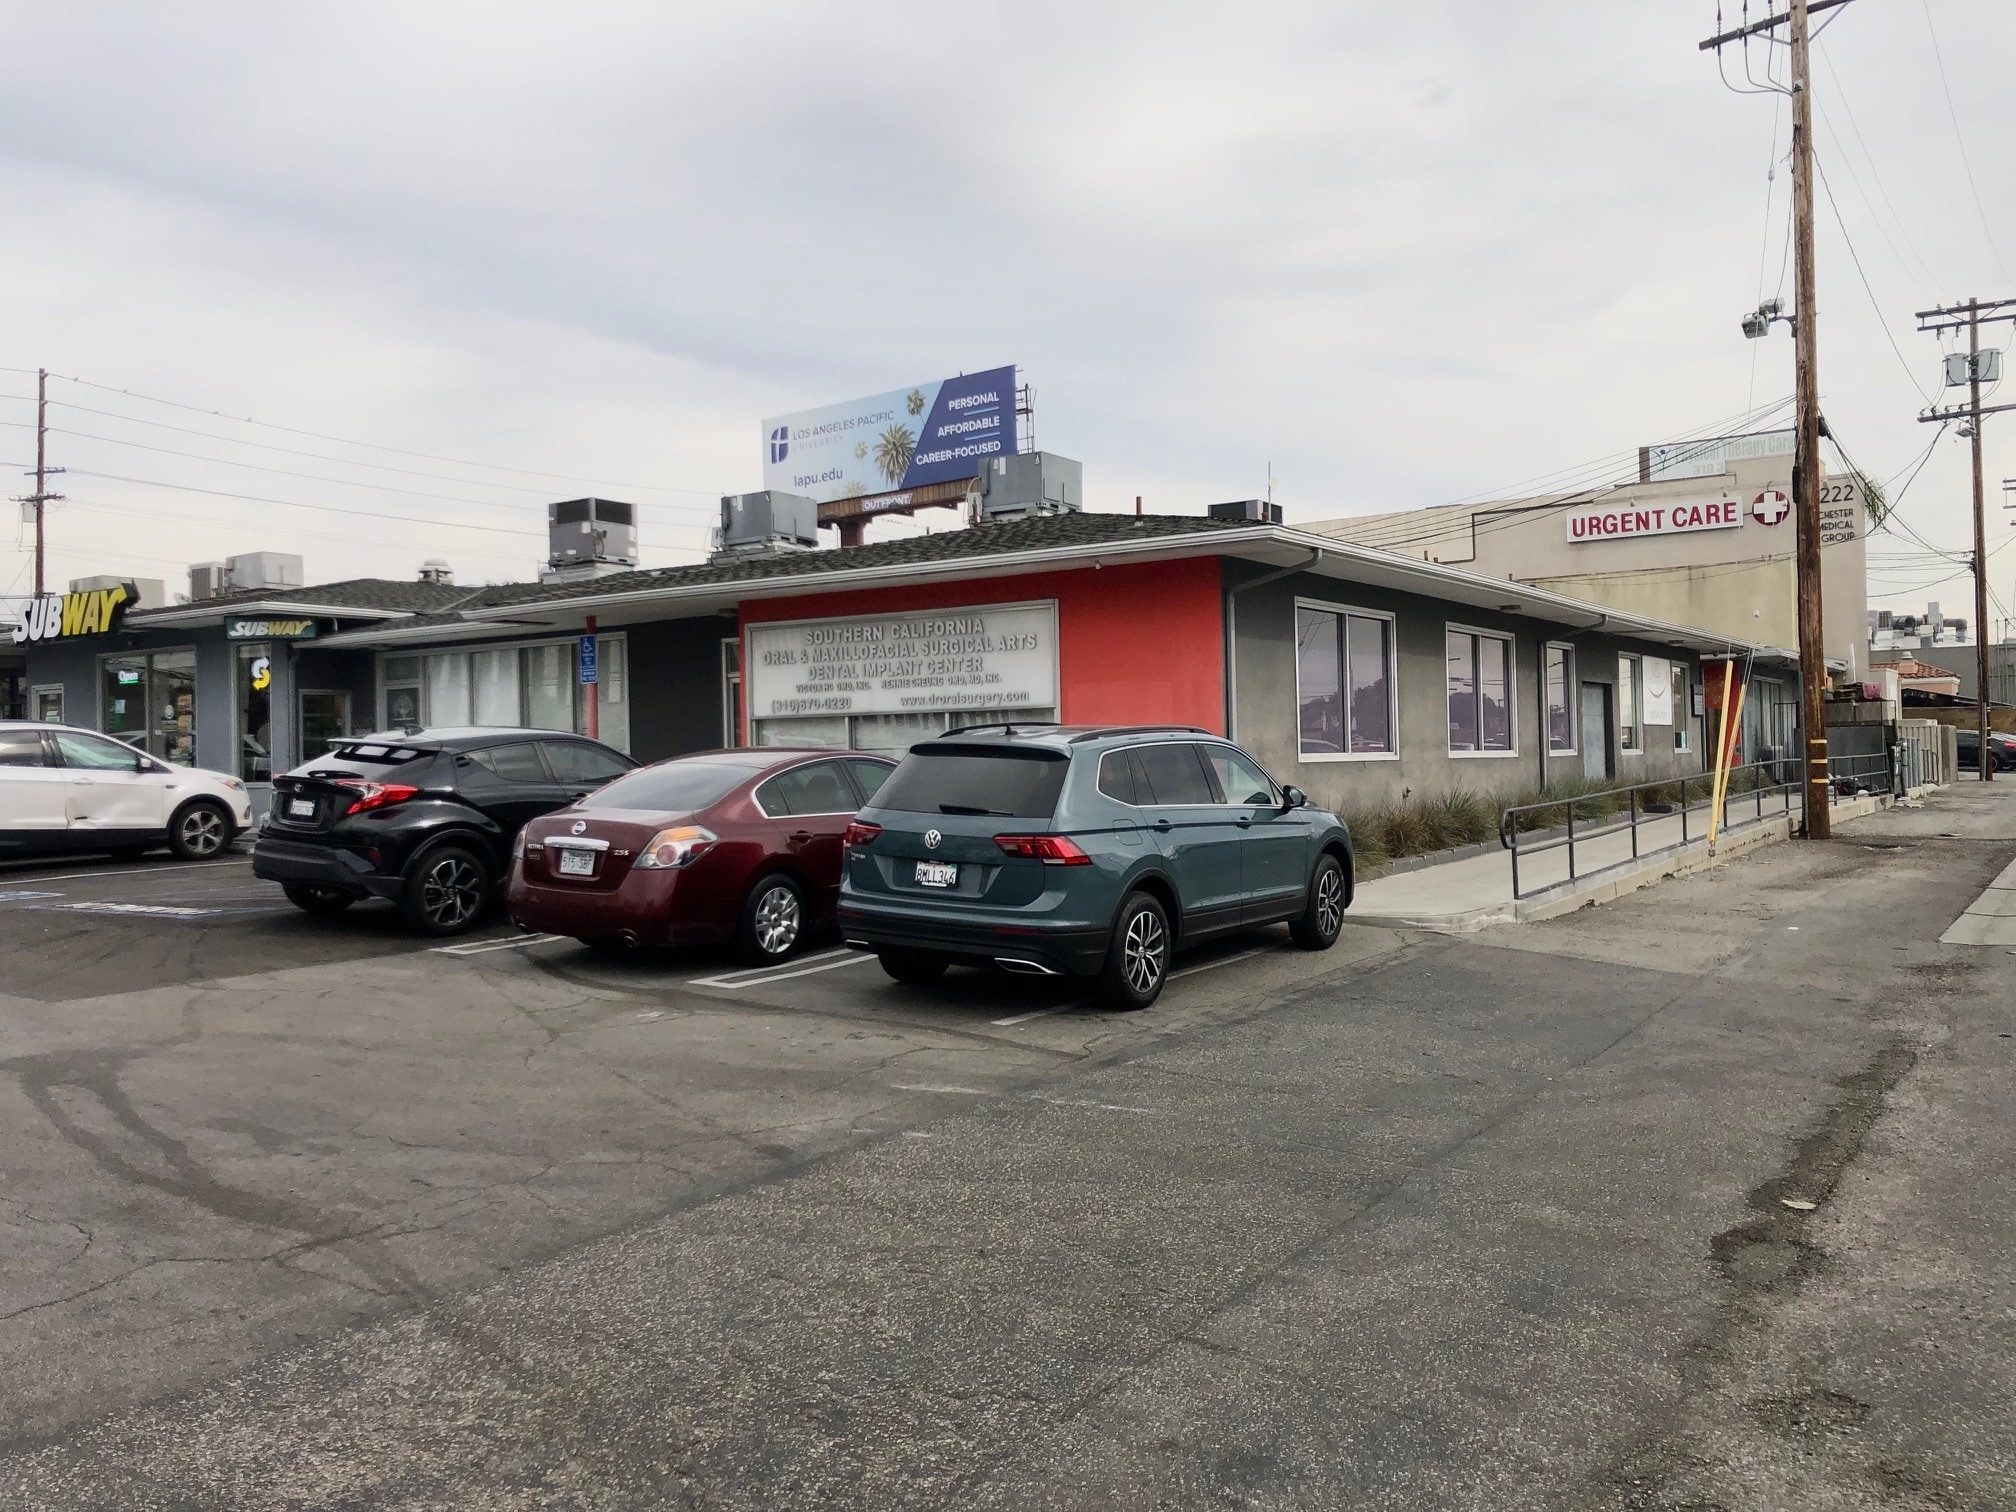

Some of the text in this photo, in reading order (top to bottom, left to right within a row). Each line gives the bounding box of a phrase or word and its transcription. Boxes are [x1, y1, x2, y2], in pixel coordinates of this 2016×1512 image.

[949, 391, 999, 411] PERSONAL
[793, 411, 895, 441] LOS ANGELES PACIFIC
[937, 415, 1000, 438] AFFORDABLE
[793, 435, 844, 452] UNIVERSITY
[916, 441, 1001, 466] CAREER-FOCUSED
[1722, 438, 1766, 458] Therapy
[794, 468, 843, 489] lapu.edu
[1820, 485, 1854, 503] 222
[1572, 502, 1737, 538] URGENT CARE
[1820, 509, 1854, 519] CHESTER
[1821, 532, 1855, 542] GROUP
[12, 583, 127, 644] SUBWAY
[229, 619, 313, 637] SUBWAY
[807, 618, 985, 645] SOUTHERN CALIFORNIA
[763, 633, 1038, 666] ORAL & MAXILLOFACIAL SURGICAL ARTS
[117, 670, 139, 682] Open
[808, 656, 984, 680] DENTAL IMPLANT CENTER
[881, 677, 910, 689] RENNIE
[911, 675, 944, 688] CHEUNG
[969, 674, 984, 685] MD,
[985, 672, 1002, 684] INC.
[900, 691, 1030, 707] www.droralsurgery.com
